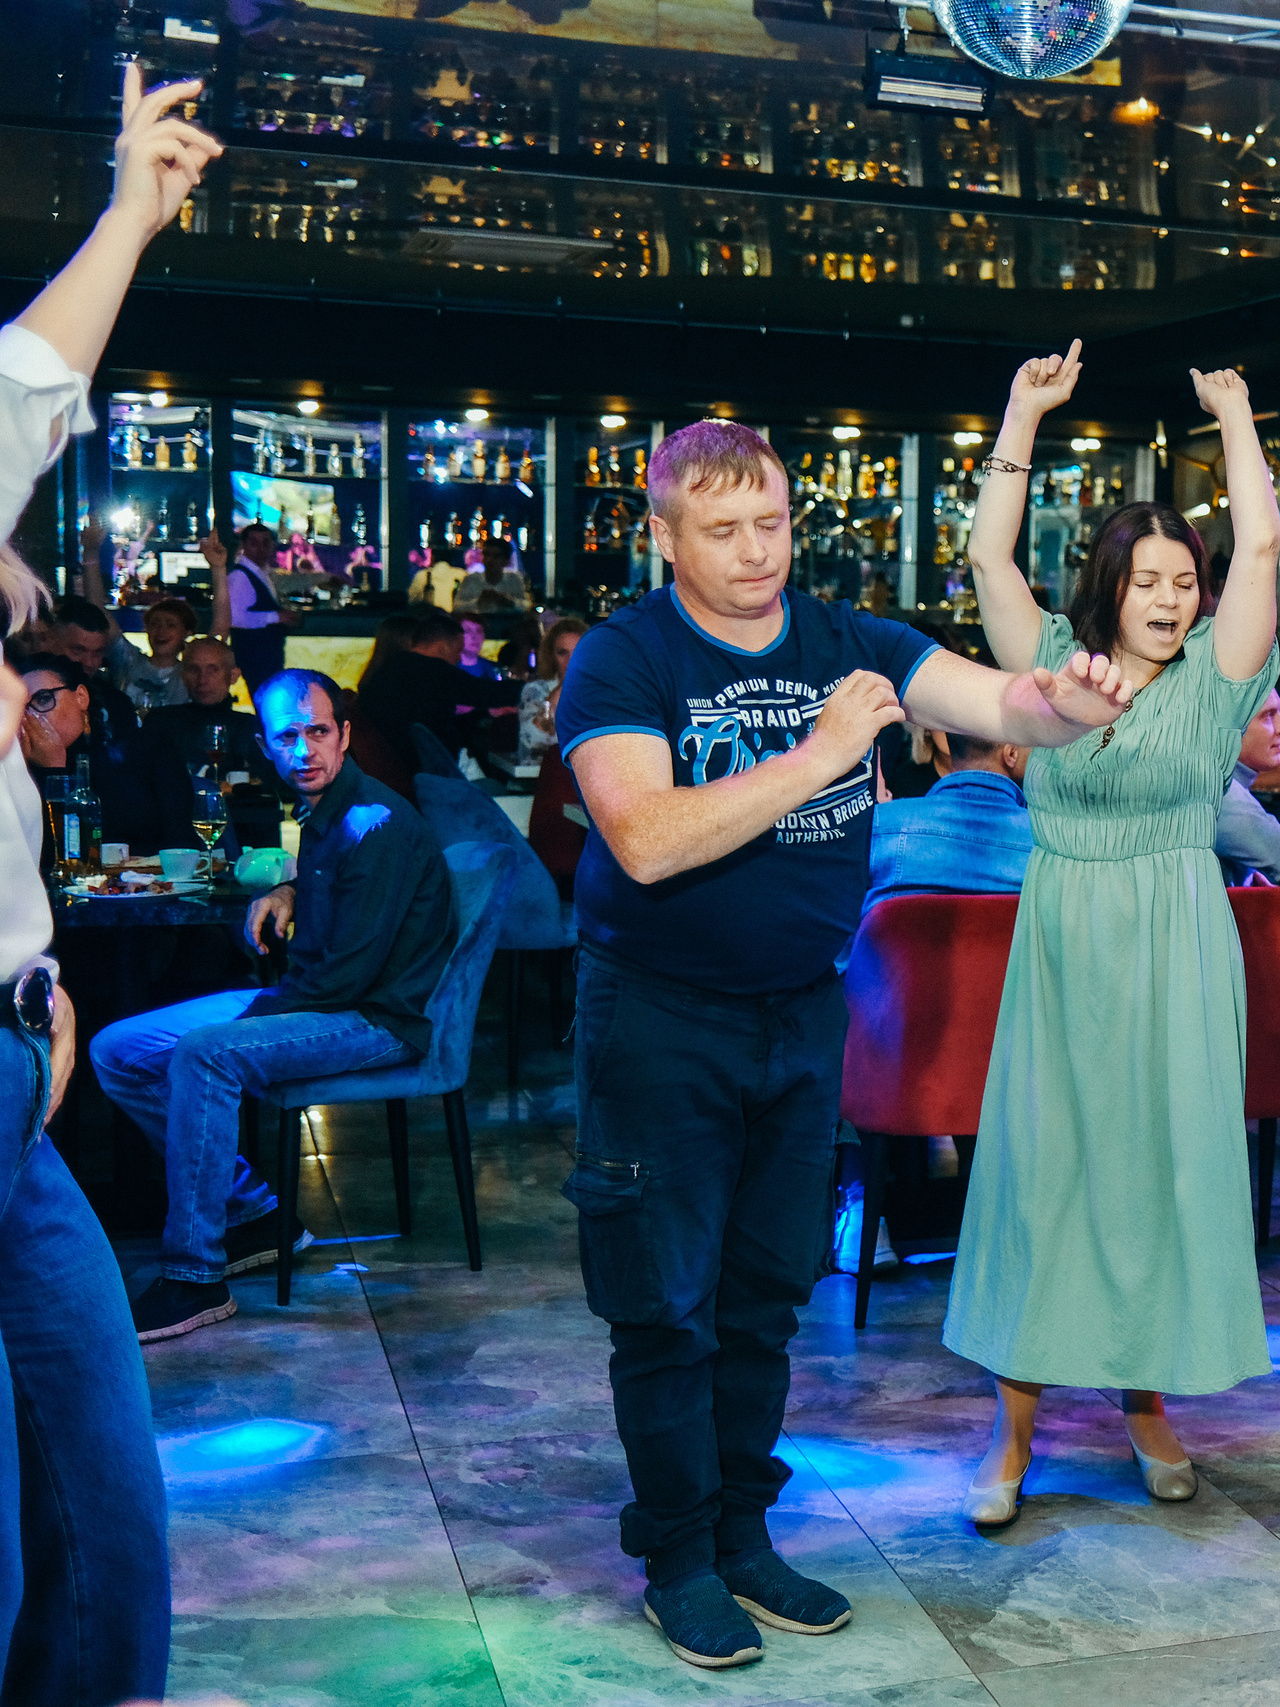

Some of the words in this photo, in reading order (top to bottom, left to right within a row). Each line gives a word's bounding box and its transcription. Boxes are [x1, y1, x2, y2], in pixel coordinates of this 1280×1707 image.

[775, 679, 819, 702] DENIM
[686, 698, 713, 708] UNION
[740, 708, 802, 728] BRAND
[831, 790, 874, 826] BRIDGE
[776, 828, 846, 844] AUTHENTIC
